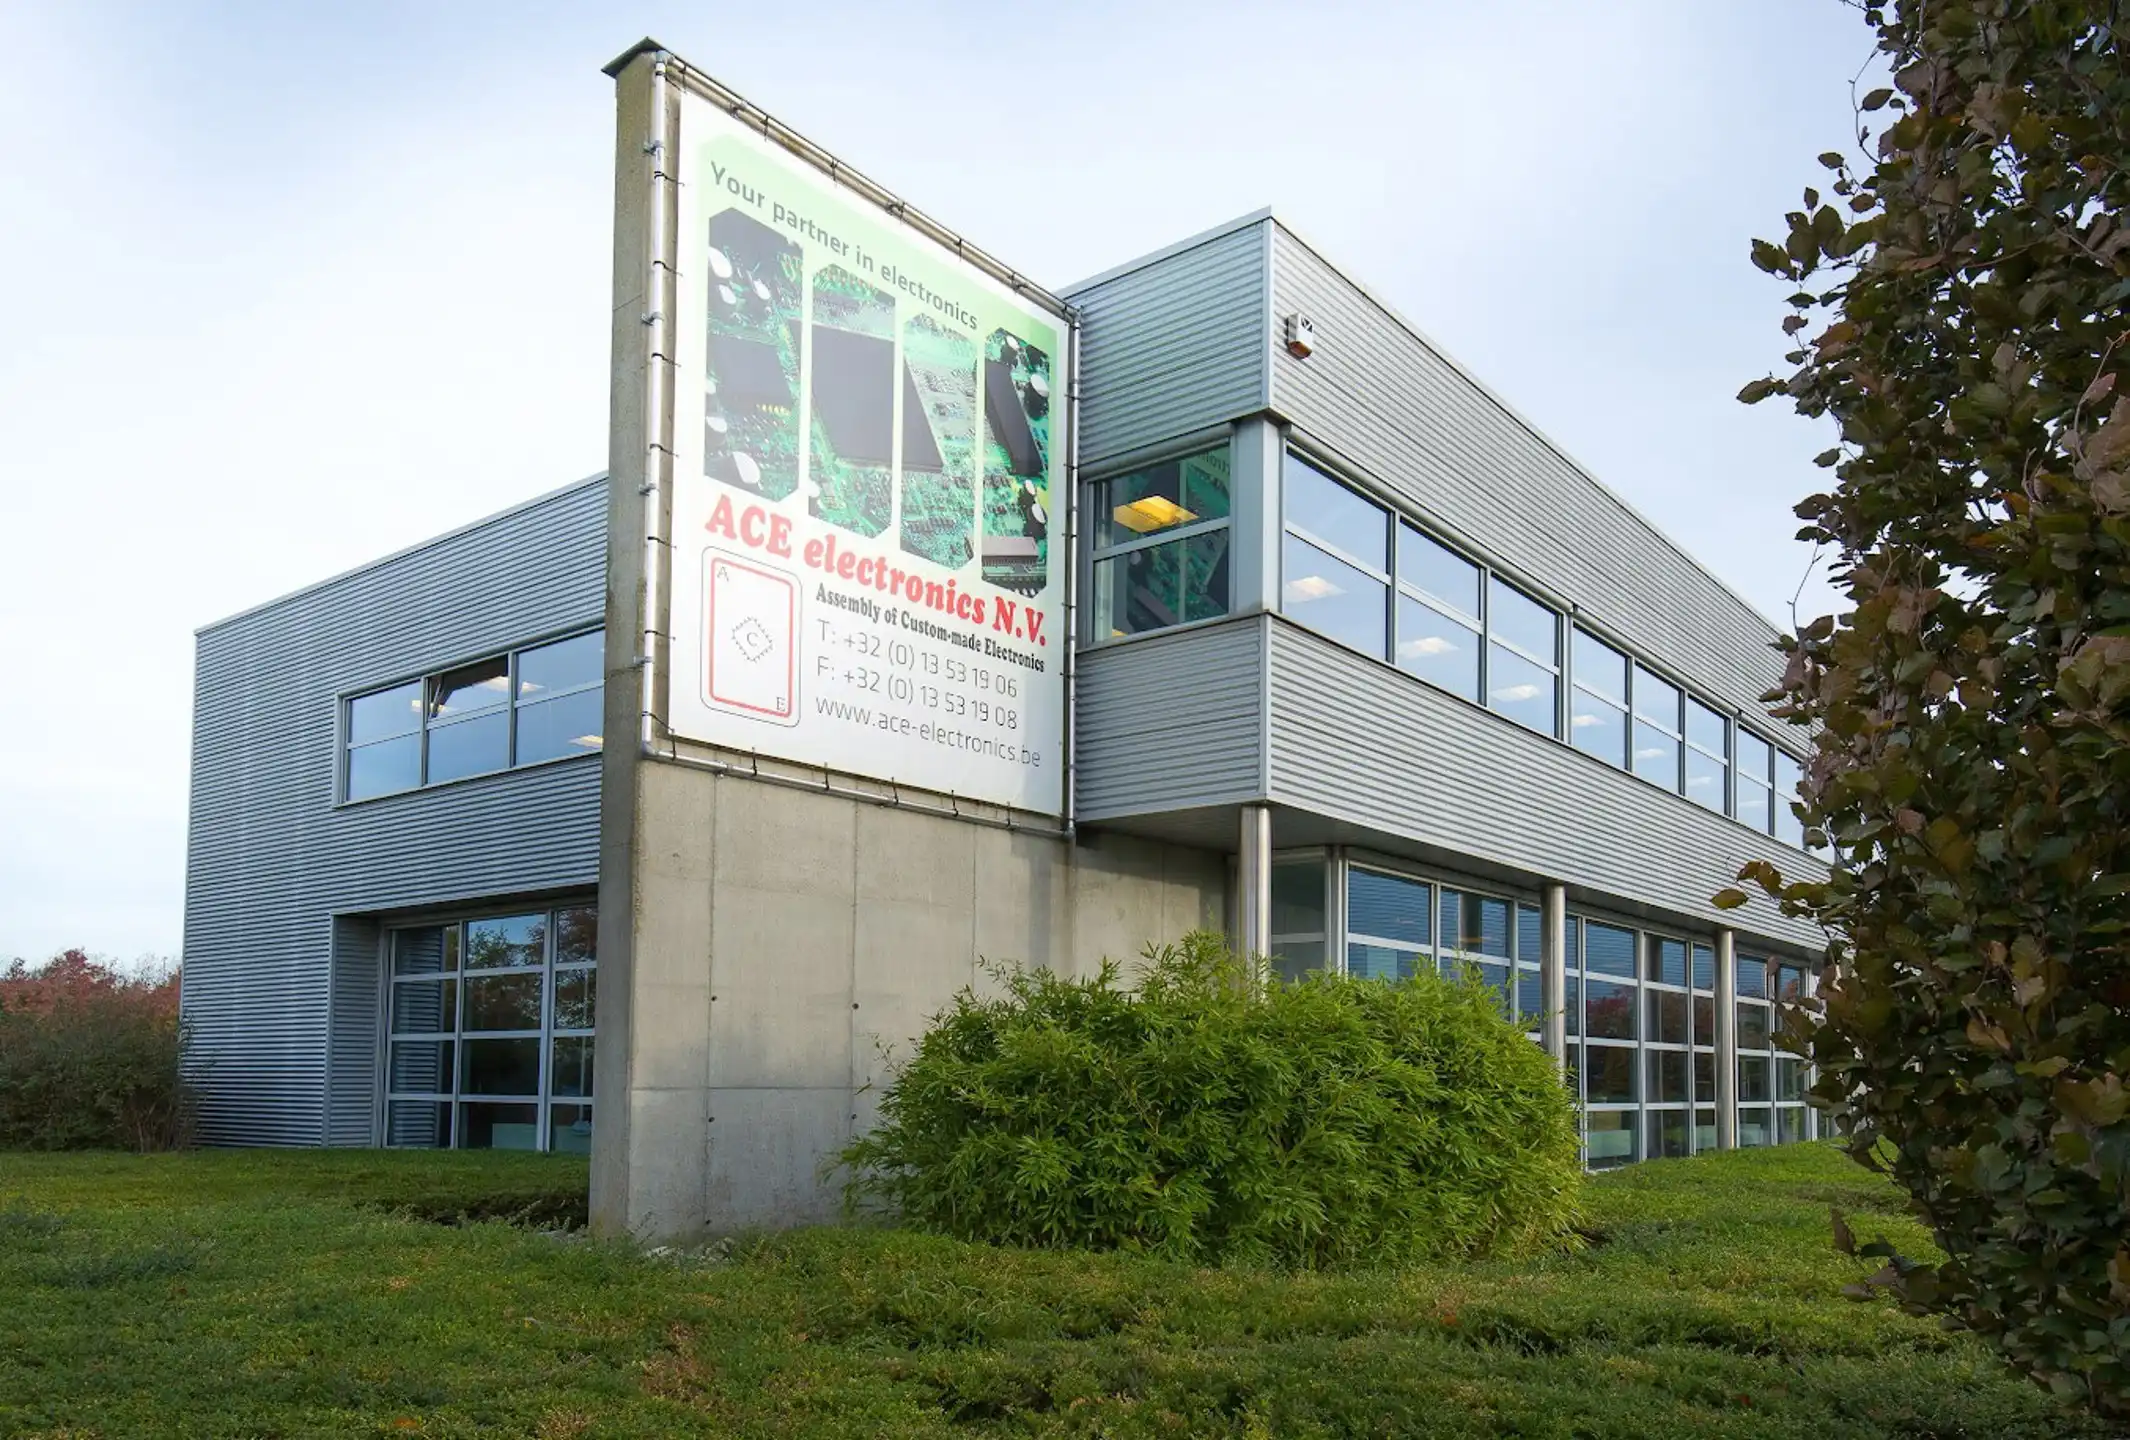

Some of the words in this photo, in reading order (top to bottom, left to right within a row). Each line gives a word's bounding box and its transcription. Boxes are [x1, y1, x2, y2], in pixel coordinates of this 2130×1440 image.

[711, 160, 765, 208] Your
[773, 201, 849, 256] partner
[856, 245, 874, 272] in
[880, 265, 978, 330] electronics
[704, 493, 793, 560] ACE
[803, 533, 986, 625] electronics
[992, 596, 1047, 647] N.V.
[717, 566, 730, 582] A
[746, 632, 759, 647] C
[816, 582, 881, 624] Assembly
[884, 607, 898, 626] of
[984, 637, 1045, 673] Electronics
[817, 618, 836, 645] T:
[844, 632, 880, 658] +32
[888, 640, 914, 671] (0)
[921, 652, 939, 674] 13
[946, 659, 967, 682] 53
[972, 668, 989, 689] 19
[995, 675, 1017, 698] 06
[817, 656, 835, 681] F:
[843, 667, 880, 693] +32
[888, 674, 913, 705] (0)
[920, 686, 938, 707] 13
[944, 692, 965, 715] 53
[971, 700, 989, 722] 19
[995, 706, 1017, 729] 08
[816, 697, 1041, 767] www.ace-electronics.be
